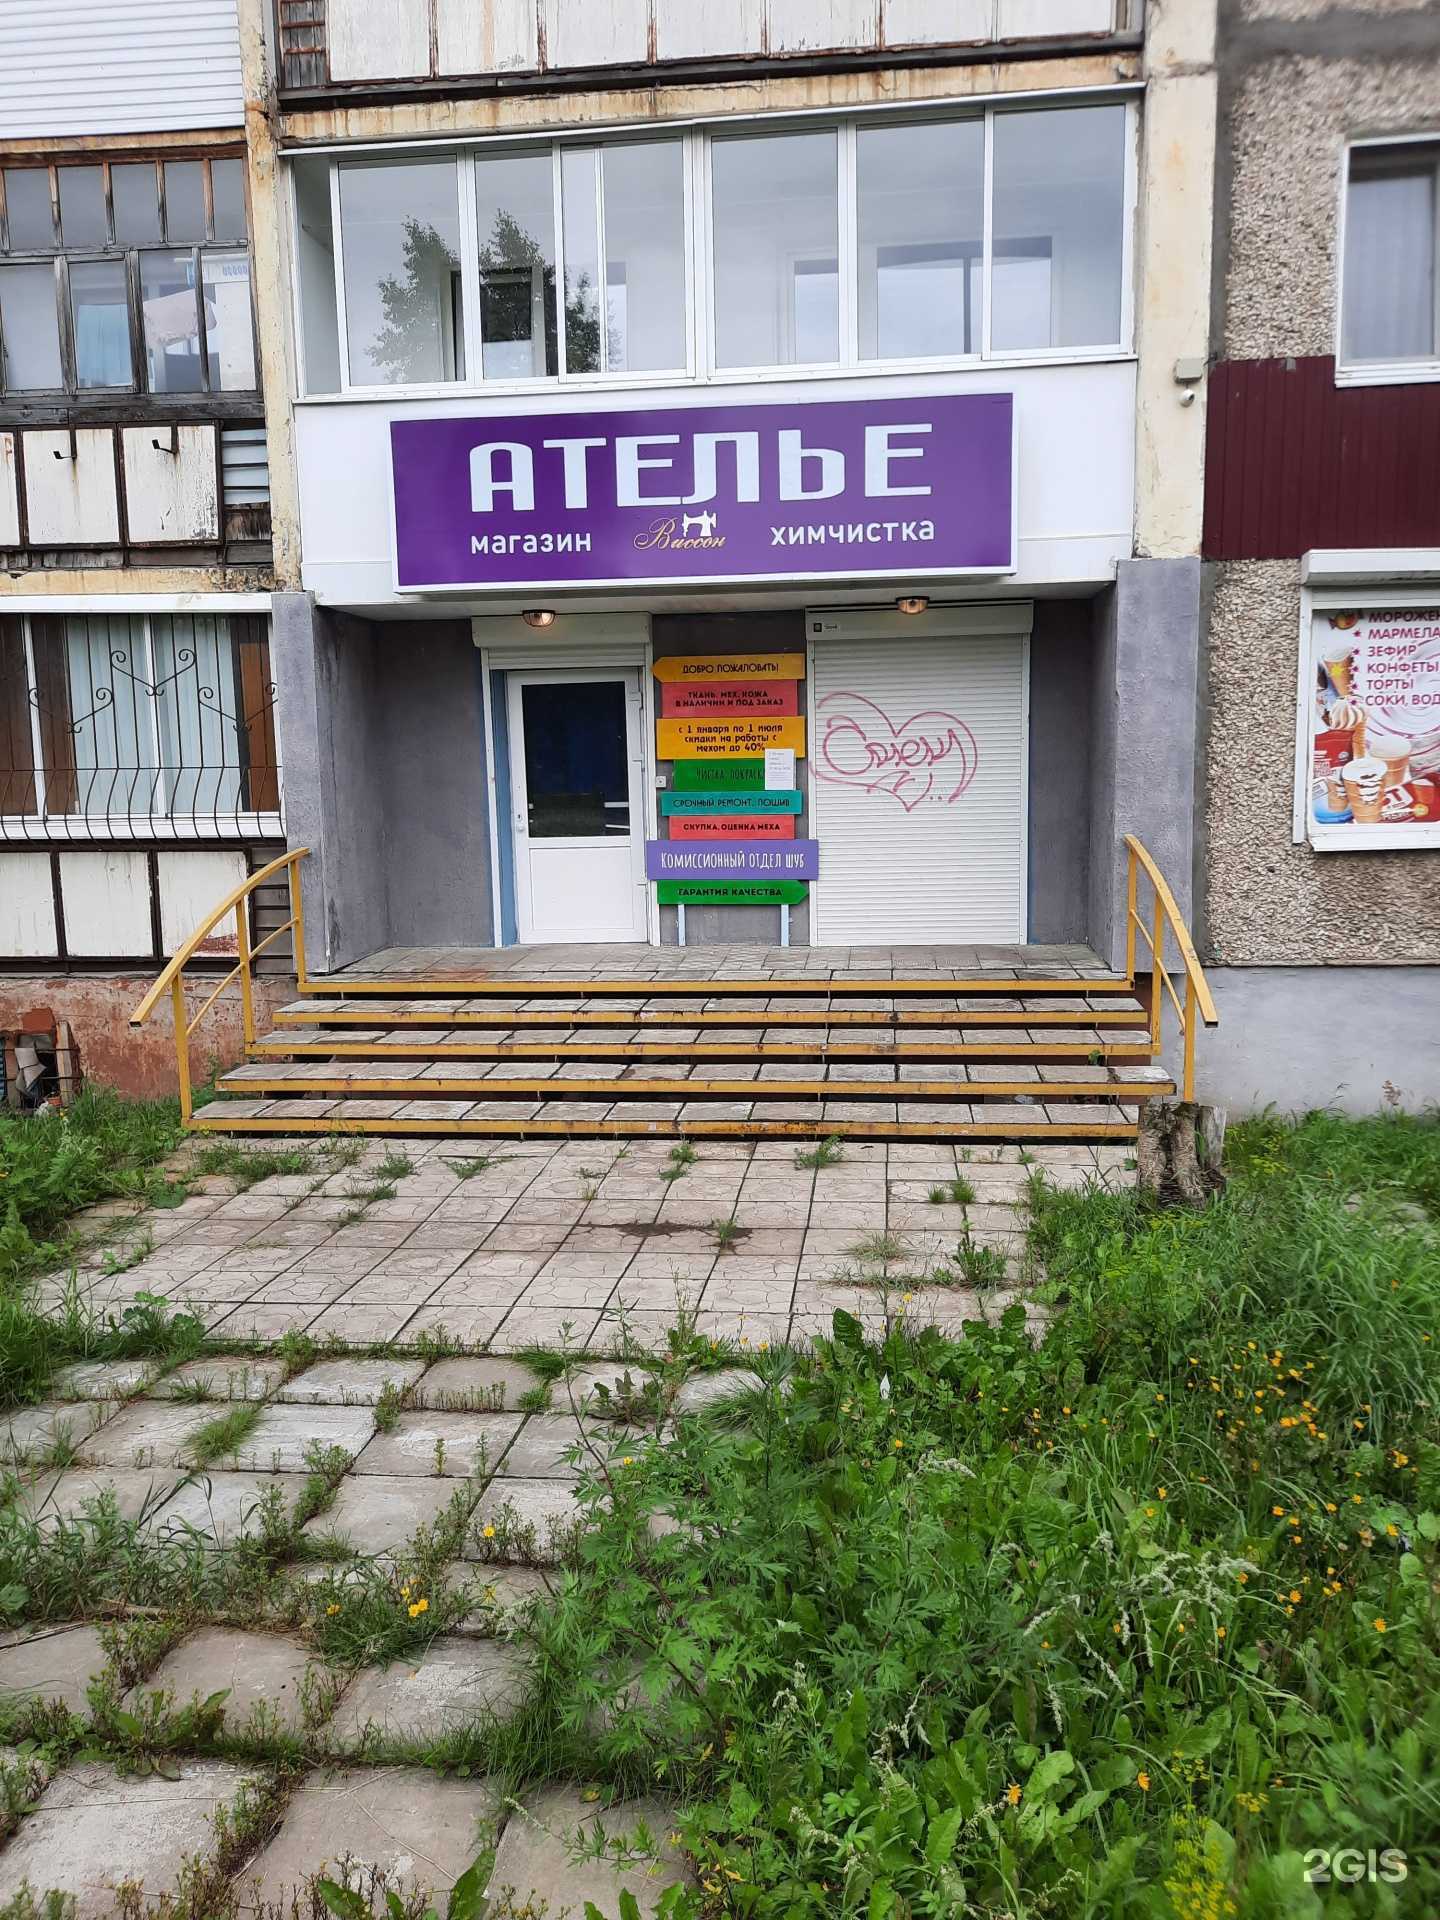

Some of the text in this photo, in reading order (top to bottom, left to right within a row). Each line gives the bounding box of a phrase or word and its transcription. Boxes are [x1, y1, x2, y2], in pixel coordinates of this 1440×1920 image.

[469, 423, 932, 512] АТЕЛЬЕ
[634, 517, 726, 550] Виссон
[770, 520, 935, 546] химчистка
[471, 533, 592, 554] магазин
[1367, 645, 1417, 657] ЗЕФИР
[682, 664, 714, 674] ДОБРО
[1367, 661, 1439, 673] КОНФЕТЫ
[1366, 679, 1414, 690] ТОРТЫ
[742, 690, 768, 698] КОЖА
[683, 699, 726, 707] НАЛИЧИИ
[735, 699, 754, 707] ПОД
[756, 698, 783, 706] ЗАКАЗ
[687, 725, 692, 733] 1
[697, 726, 730, 737] января
[749, 724, 753, 732] 1
[720, 735, 731, 743] на
[735, 733, 769, 743] работы
[696, 742, 765, 752] мехом до 40%
[673, 798, 714, 808] СРОЧНЫЙ
[721, 823, 755, 831] ОЦЕНКА
[757, 823, 780, 831] МЕХА
[749, 853, 782, 869] ОТДЕЛ
[785, 853, 805, 868] ШУБ
[678, 888, 782, 896] ГАРАНТИЯ КАЧЕСТВА
